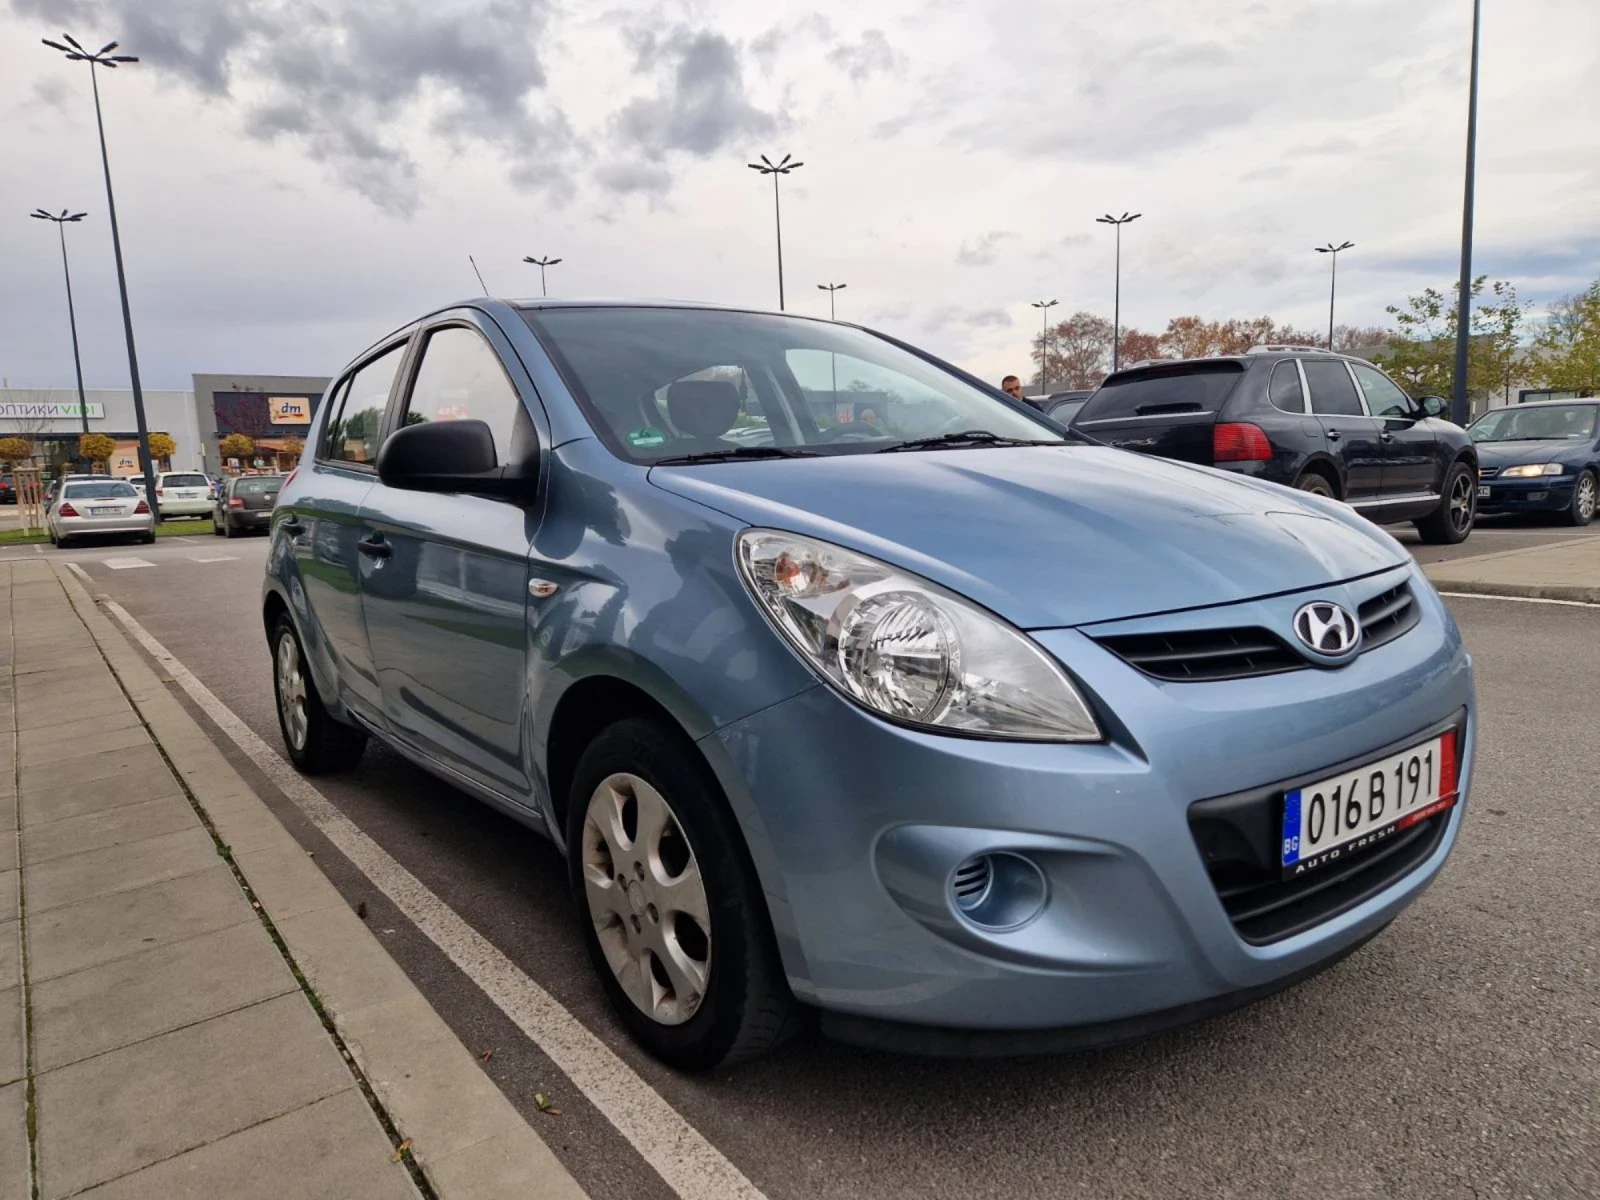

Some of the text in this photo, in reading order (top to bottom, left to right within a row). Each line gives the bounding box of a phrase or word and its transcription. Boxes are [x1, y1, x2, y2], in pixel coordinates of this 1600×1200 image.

[281, 402, 301, 413] dm
[1283, 835, 1299, 855] BG
[1295, 825, 1396, 874] AUTO FRESH
